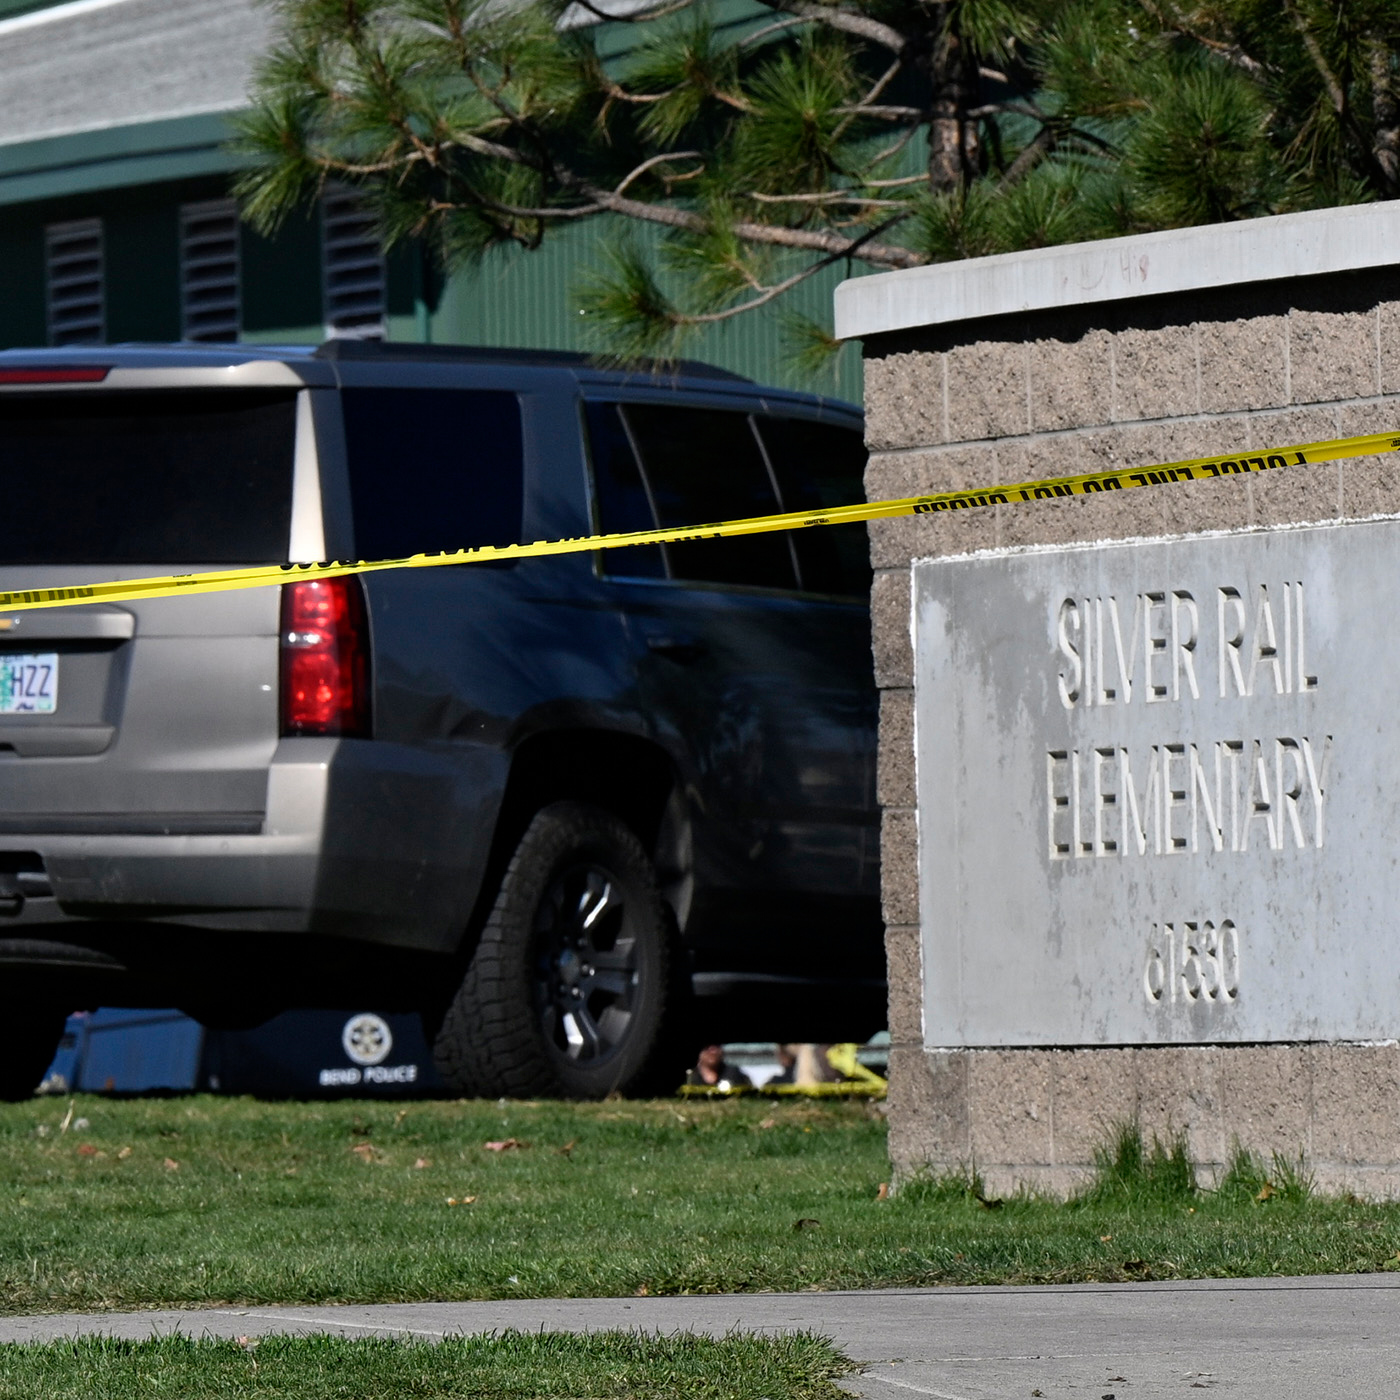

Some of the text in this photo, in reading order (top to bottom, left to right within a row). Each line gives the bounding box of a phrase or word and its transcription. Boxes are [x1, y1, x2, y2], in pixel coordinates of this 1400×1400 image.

[1057, 580, 1319, 710] SILVER RAIL
[1047, 734, 1333, 860] ELEMENTARY
[363, 1064, 418, 1084] POLICE
